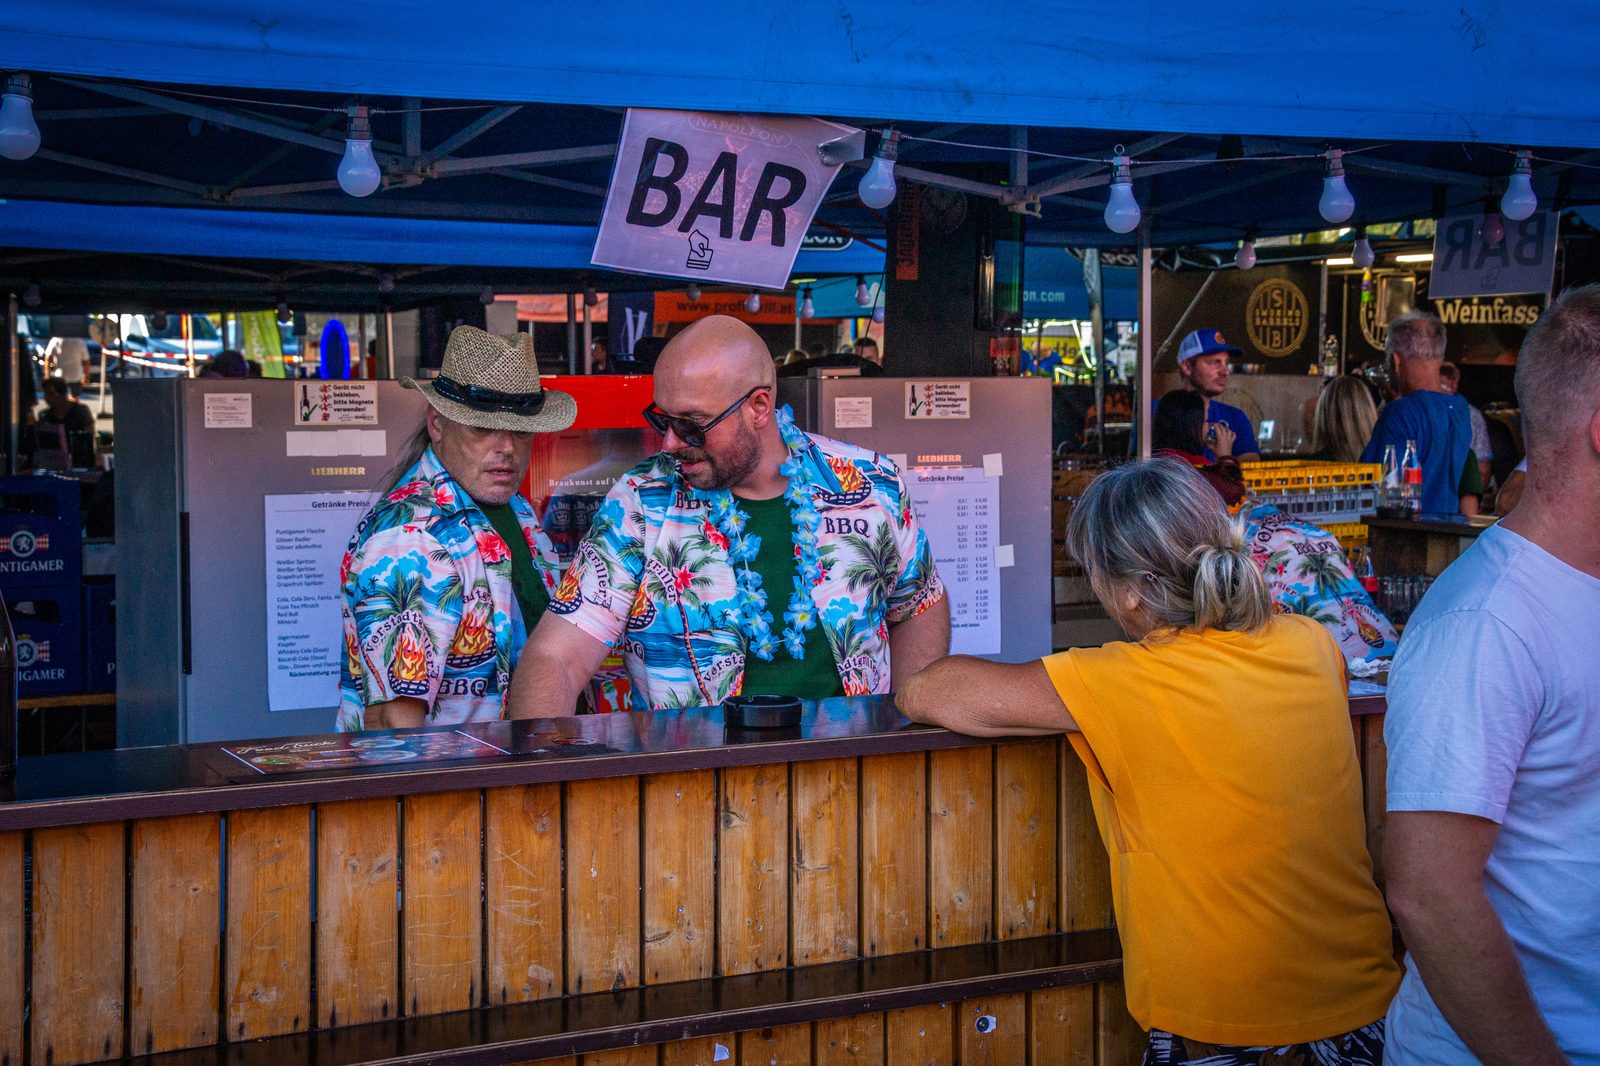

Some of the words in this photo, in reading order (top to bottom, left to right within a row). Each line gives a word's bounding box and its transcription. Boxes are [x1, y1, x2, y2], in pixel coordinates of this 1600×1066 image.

[626, 137, 807, 247] BAR
[1435, 297, 1540, 325] Weinfass
[917, 454, 962, 463] LIEBHERR
[311, 466, 365, 476] LIEBHERR
[549, 479, 592, 487] Braukunst
[312, 500, 346, 508] Getränke
[348, 500, 370, 508] Preise
[824, 516, 870, 539] BBQ
[438, 678, 488, 697] BBQ
